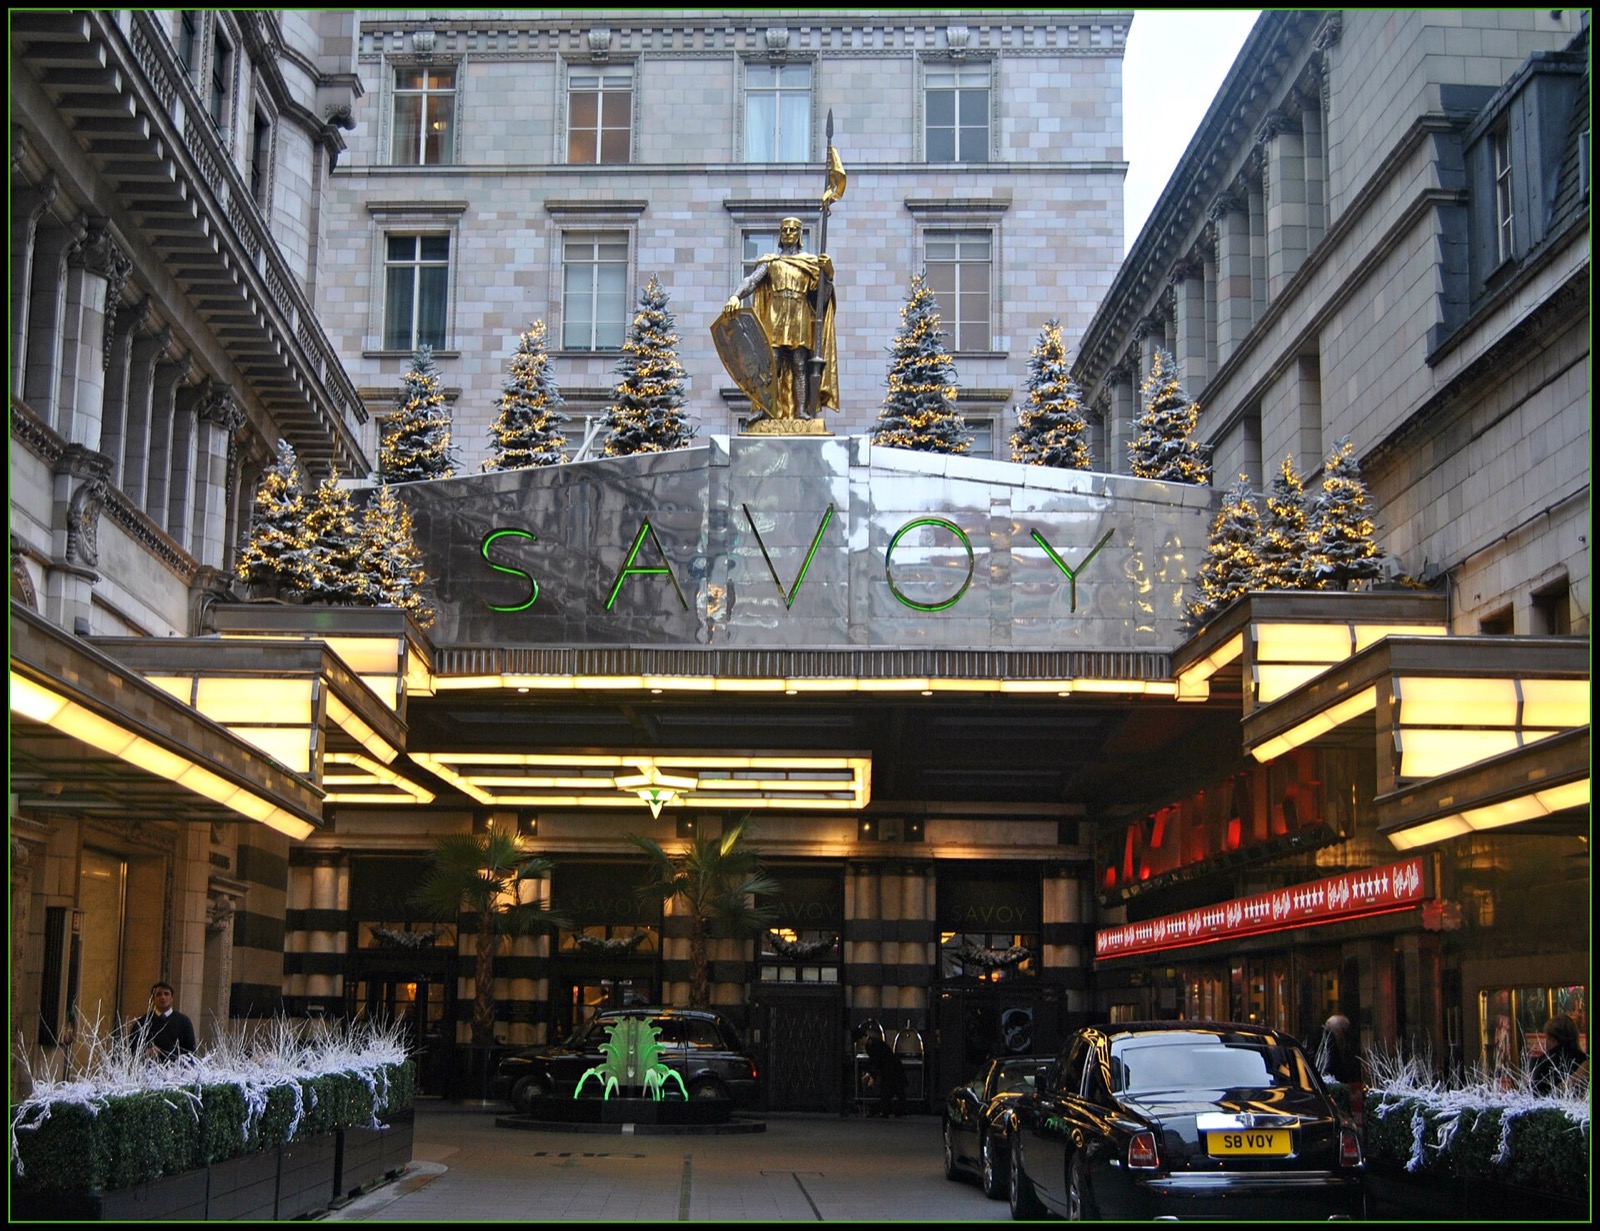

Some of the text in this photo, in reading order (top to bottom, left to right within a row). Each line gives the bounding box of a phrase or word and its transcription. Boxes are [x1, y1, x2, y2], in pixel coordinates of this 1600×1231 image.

[481, 502, 1115, 613] SAVOY
[951, 903, 1027, 923] SAVOY
[1224, 1134, 1273, 1148] S8 VOY
